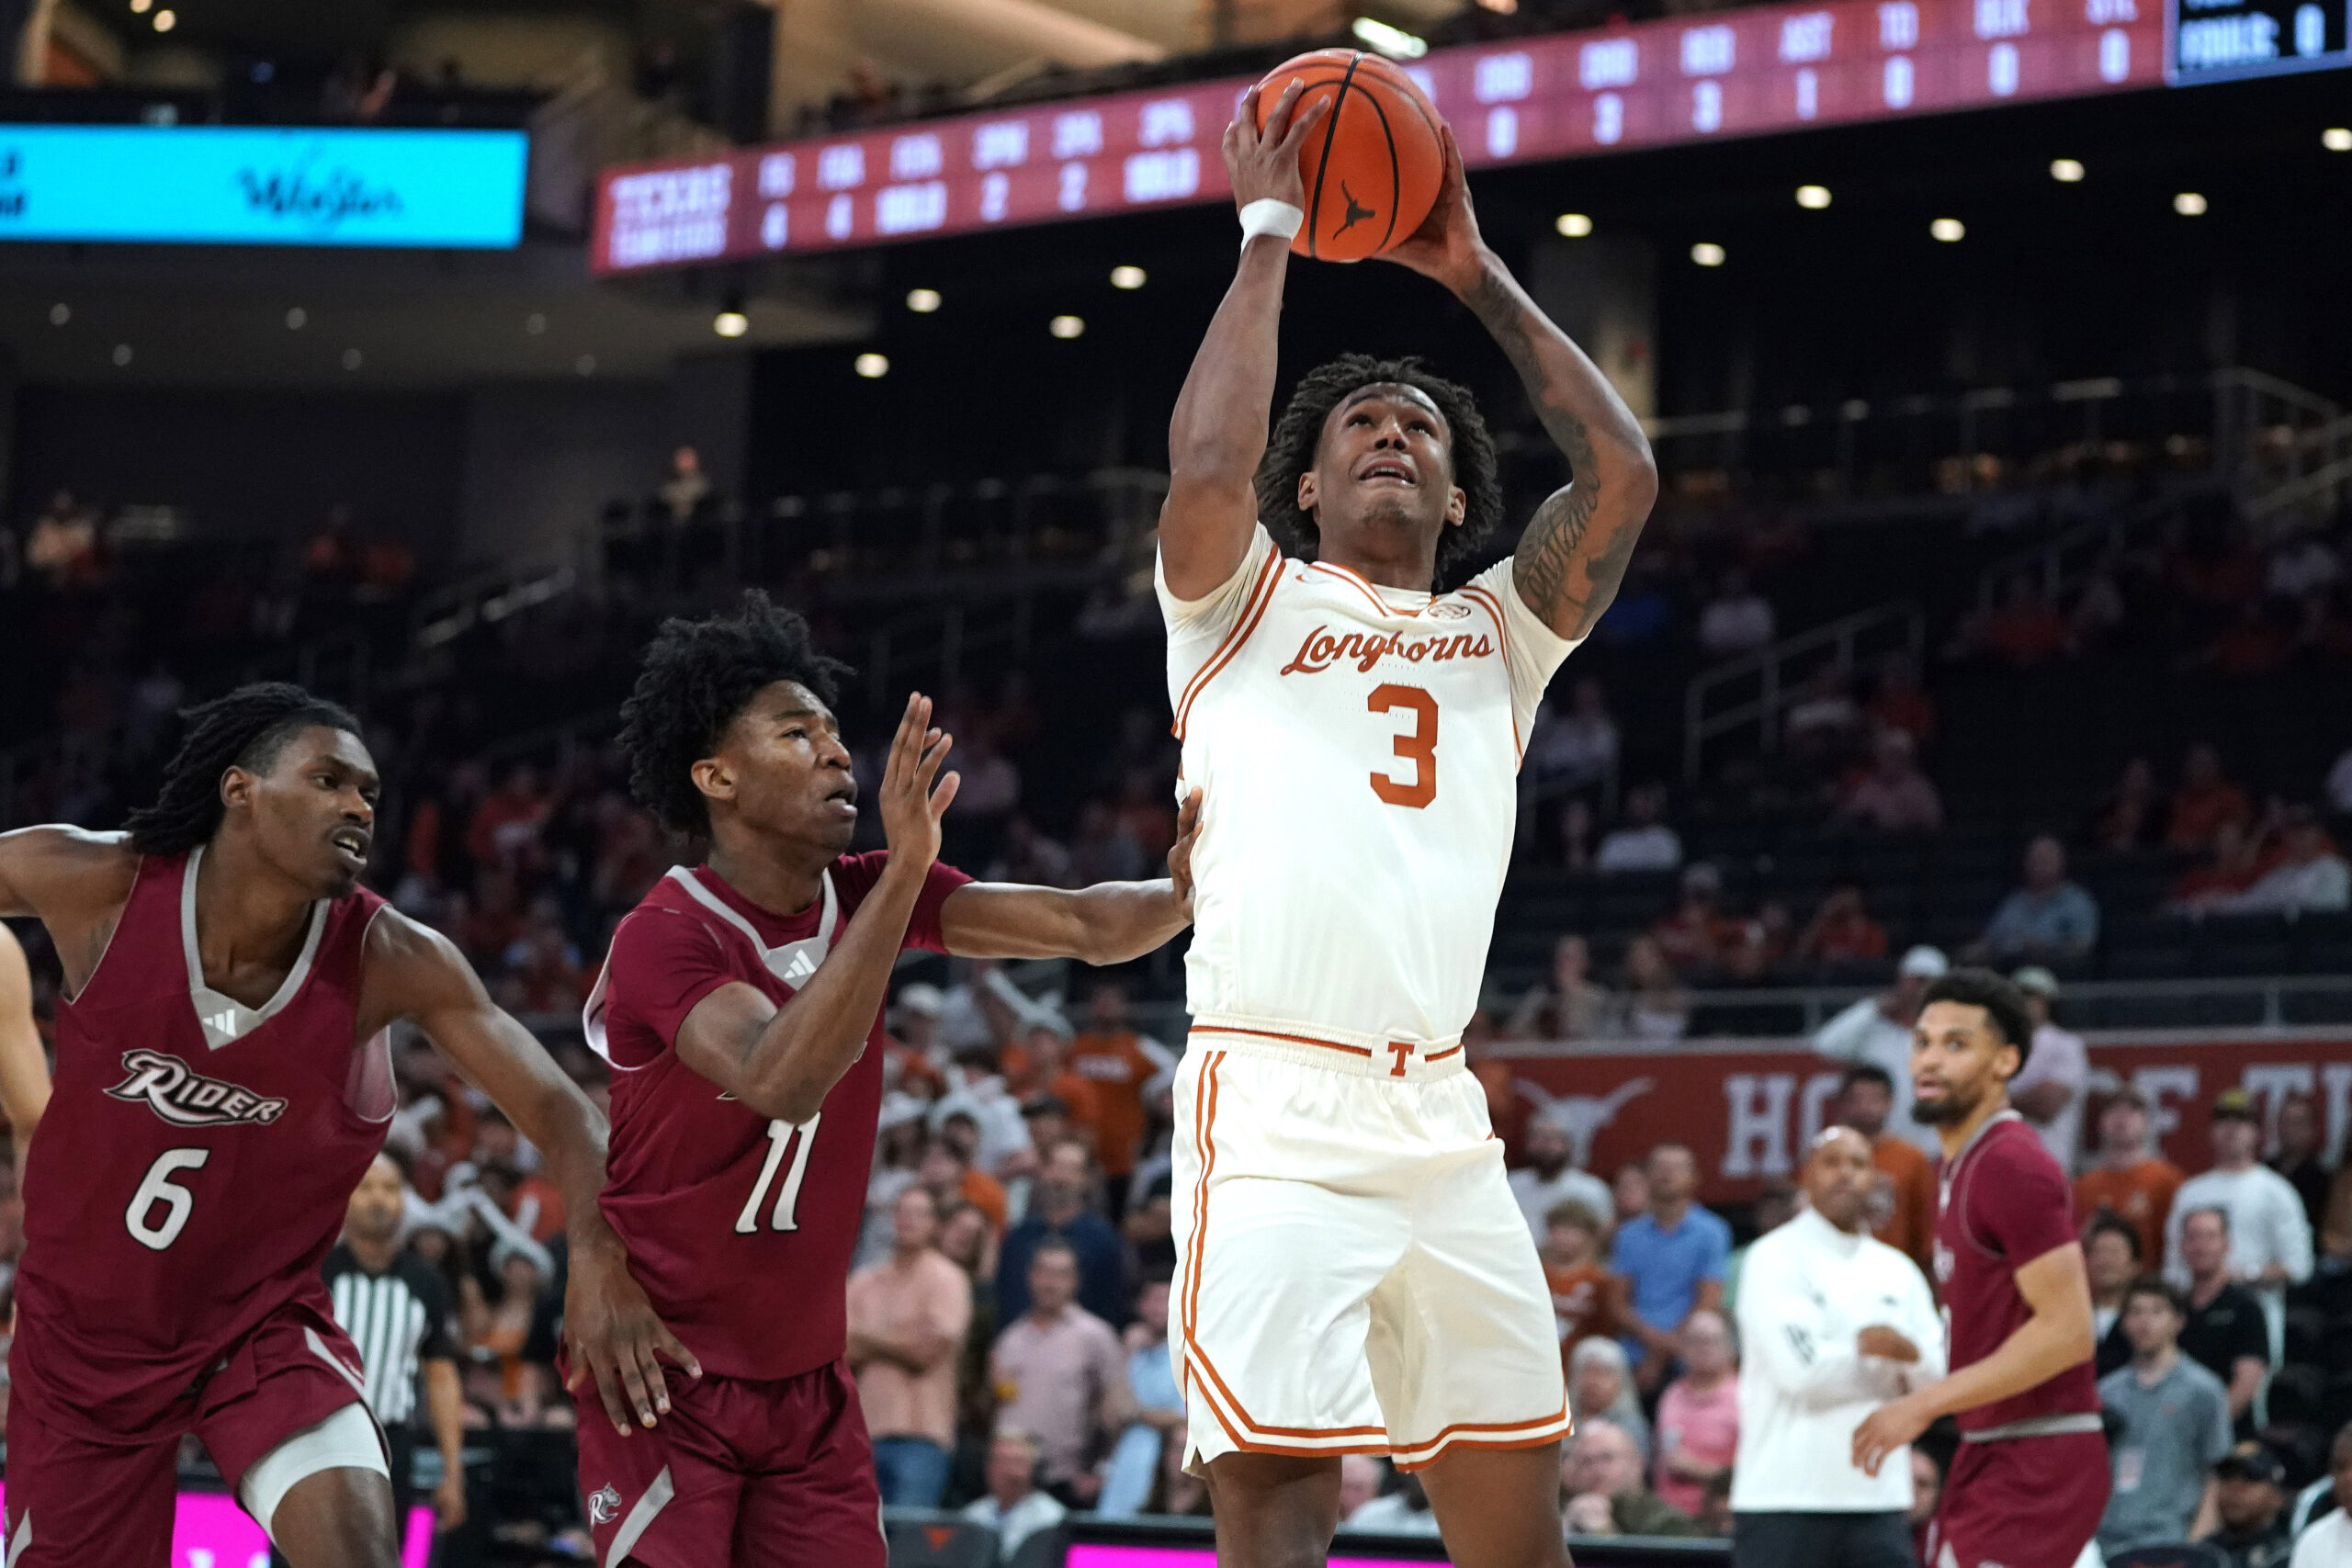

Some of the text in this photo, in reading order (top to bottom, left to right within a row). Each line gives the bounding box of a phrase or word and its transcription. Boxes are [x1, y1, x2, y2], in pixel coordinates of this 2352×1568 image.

[1280, 625, 1495, 676] Longhorns
[1367, 683, 1439, 809] 3
[1387, 1041, 1415, 1077] T
[124, 1146, 210, 1252] 6
[735, 1110, 821, 1235] 11
